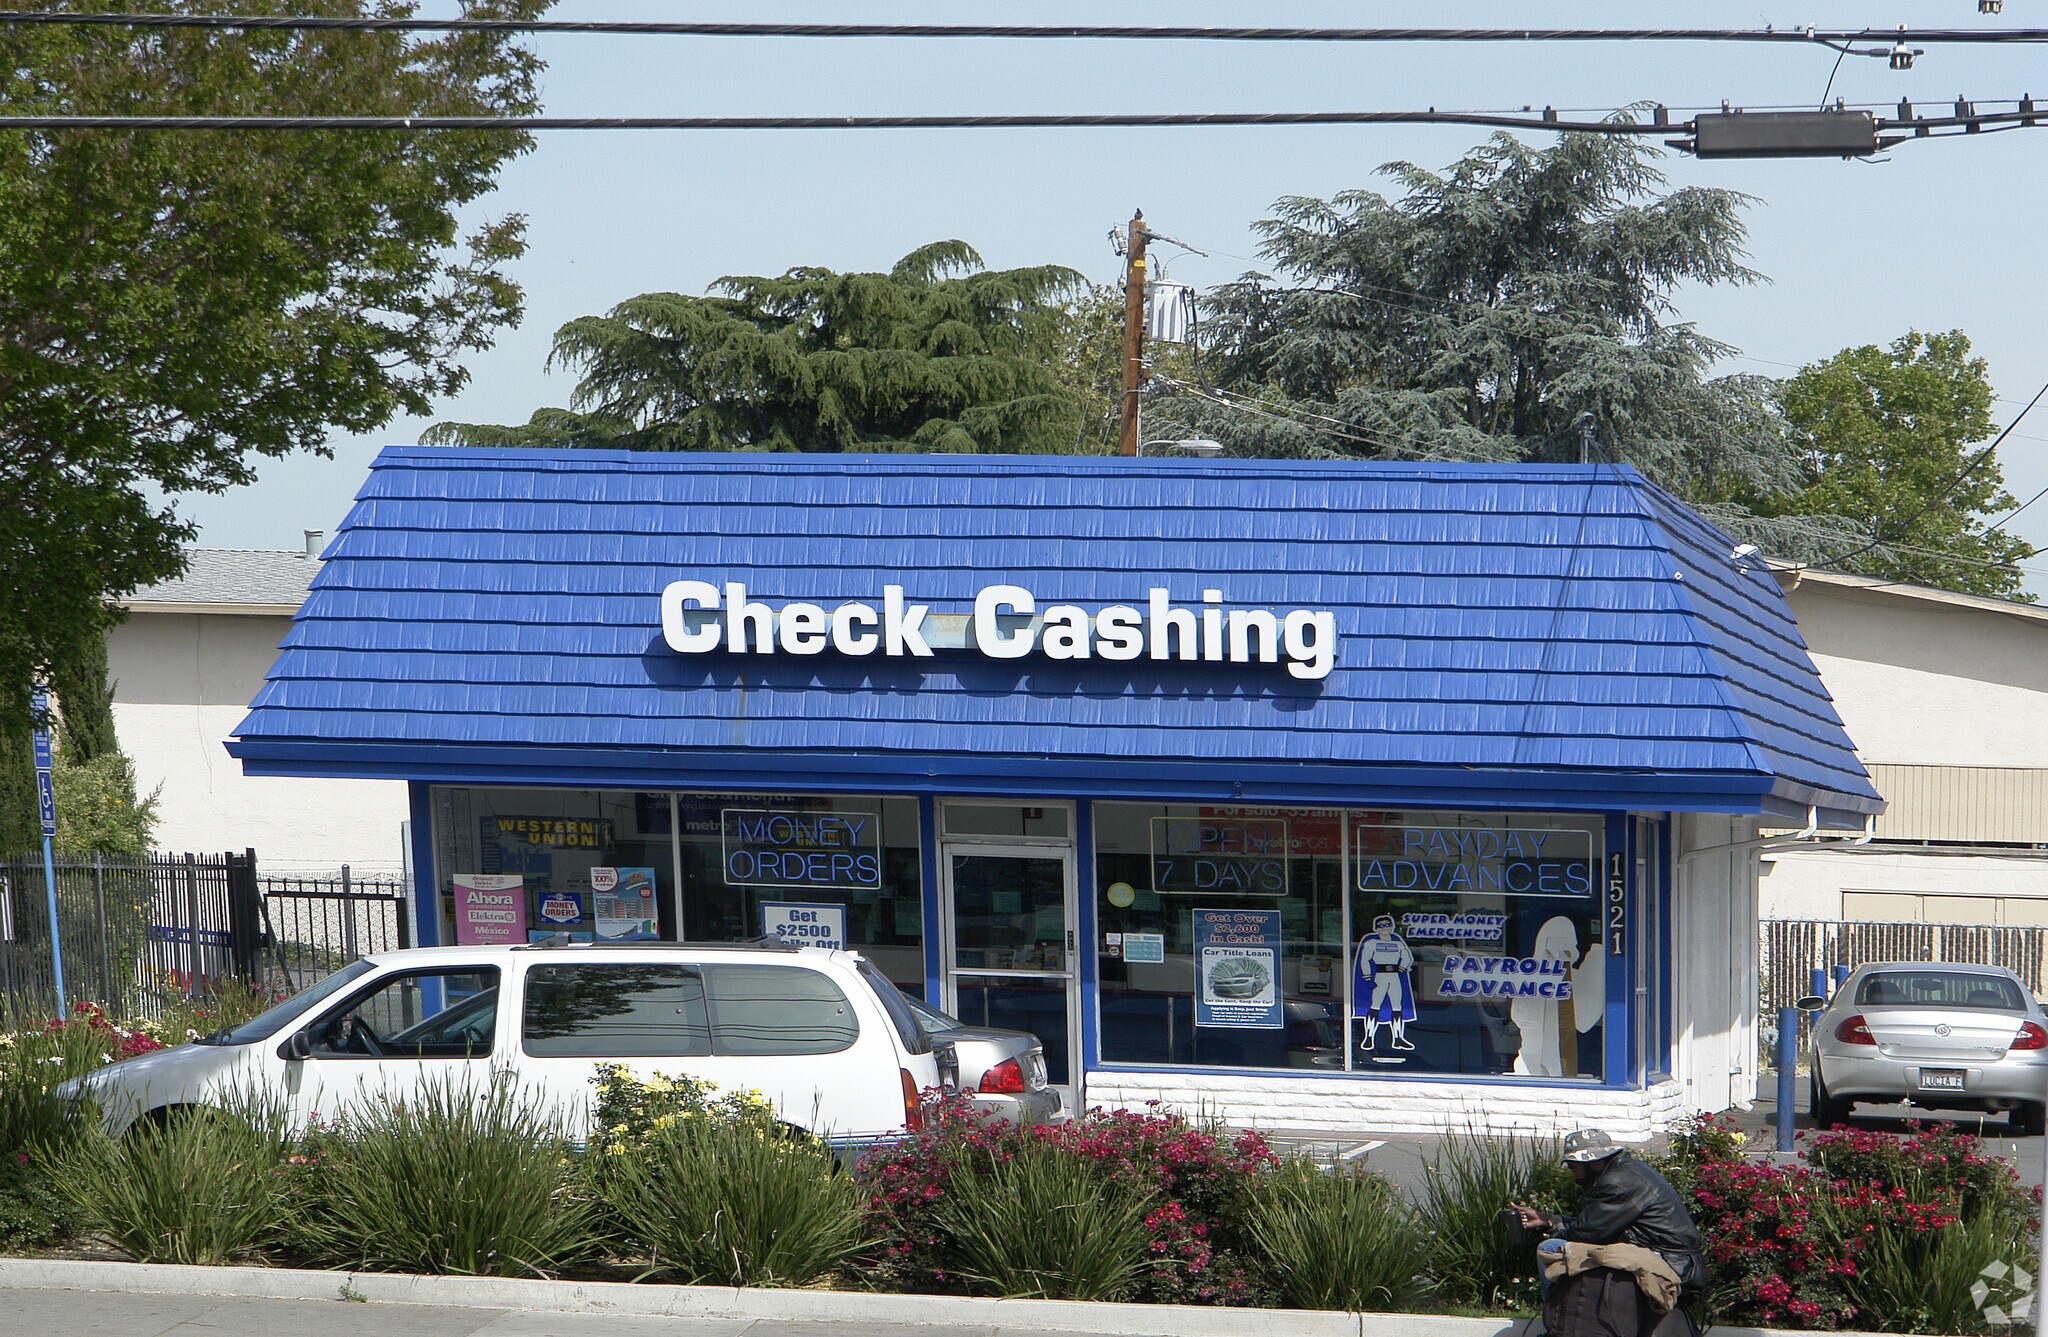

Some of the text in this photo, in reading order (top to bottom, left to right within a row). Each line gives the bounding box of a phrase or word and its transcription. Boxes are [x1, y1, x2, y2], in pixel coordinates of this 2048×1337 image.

[660, 580, 1335, 680] Check Cashing
[497, 819, 593, 833] WESTERN
[738, 816, 865, 846] MONEY
[529, 833, 594, 847] UNION
[1168, 823, 1268, 855] OPEN
[1404, 829, 1548, 860] PAYDAY
[730, 850, 879, 883] ORDERS
[594, 875, 613, 883] 100%
[1157, 860, 1283, 890] 7 DAYS
[1363, 859, 1590, 894] ADVANCES
[466, 892, 513, 905] Ahora
[546, 901, 574, 909] MONEY
[1609, 853, 1624, 954] 1521
[470, 911, 505, 921] Elektra
[545, 909, 576, 917] ORDERS
[789, 909, 817, 923] Get
[1204, 913, 1268, 923] Get Over
[1402, 913, 1507, 926] SUPER MONEY
[475, 926, 510, 935] México
[776, 924, 831, 938] $2500
[1215, 923, 1260, 934] $2,600
[1406, 926, 1502, 940] EMERGENCY?
[1210, 934, 1264, 944] in Cash!
[1222, 949, 1244, 957] Title
[1444, 956, 1565, 976] PAYROLL
[1439, 979, 1572, 998] ADVANCE
